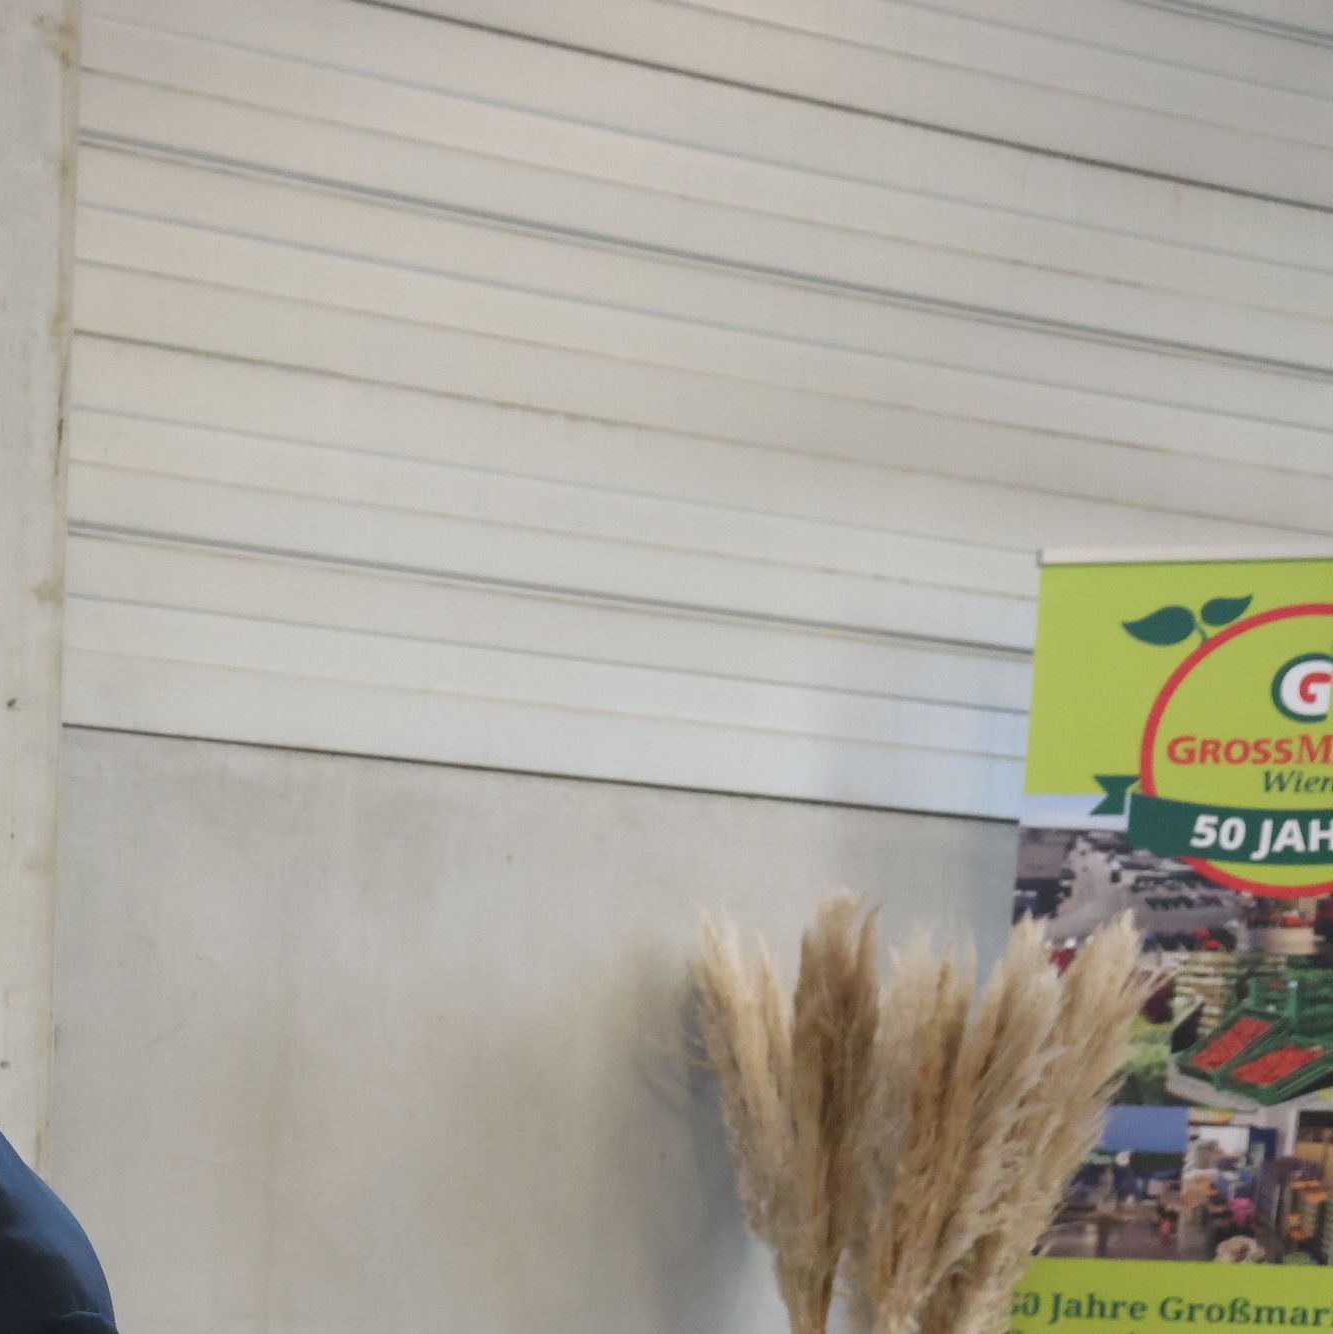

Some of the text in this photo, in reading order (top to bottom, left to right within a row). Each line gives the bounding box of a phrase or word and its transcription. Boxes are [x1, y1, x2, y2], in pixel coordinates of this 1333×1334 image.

[1189, 813, 1246, 851] 50
[1048, 1292, 1148, 1324] Jahre
[1158, 1296, 1333, 1327] Großmar
